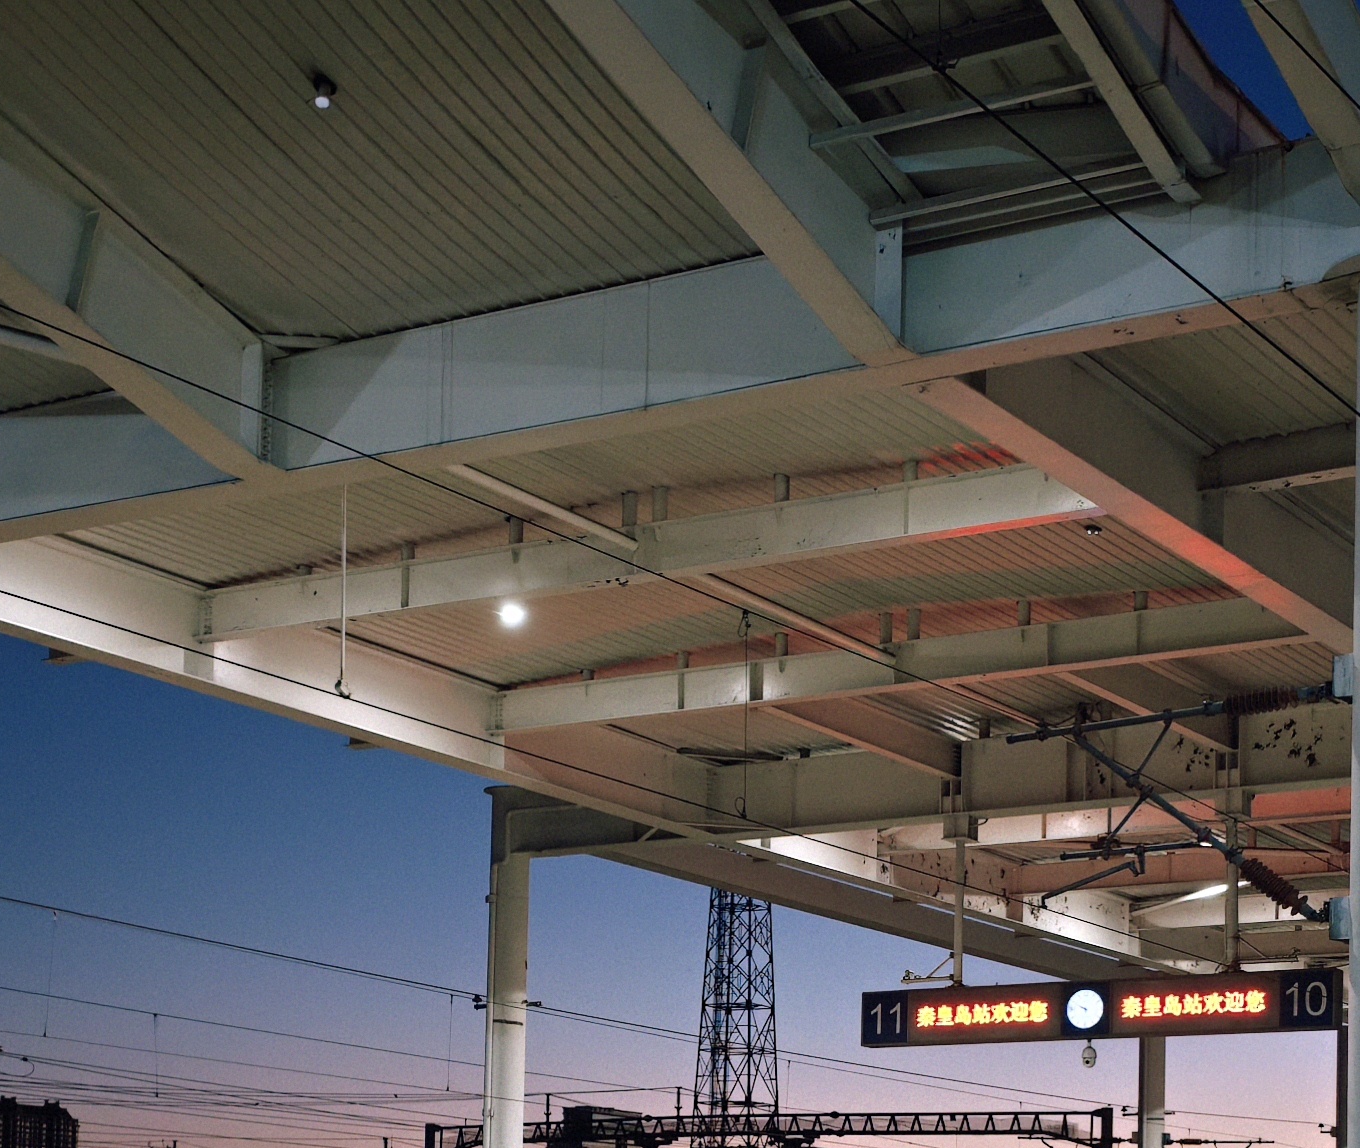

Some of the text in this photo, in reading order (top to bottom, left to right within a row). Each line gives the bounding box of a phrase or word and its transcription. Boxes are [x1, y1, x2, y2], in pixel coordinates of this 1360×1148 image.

[916, 1000, 1049, 1028] 秦皇岛站欢迎您
[1121, 989, 1266, 1019] 秦皇岛站欢迎您
[1285, 981, 1329, 1018] 10
[869, 1003, 903, 1036] 11
